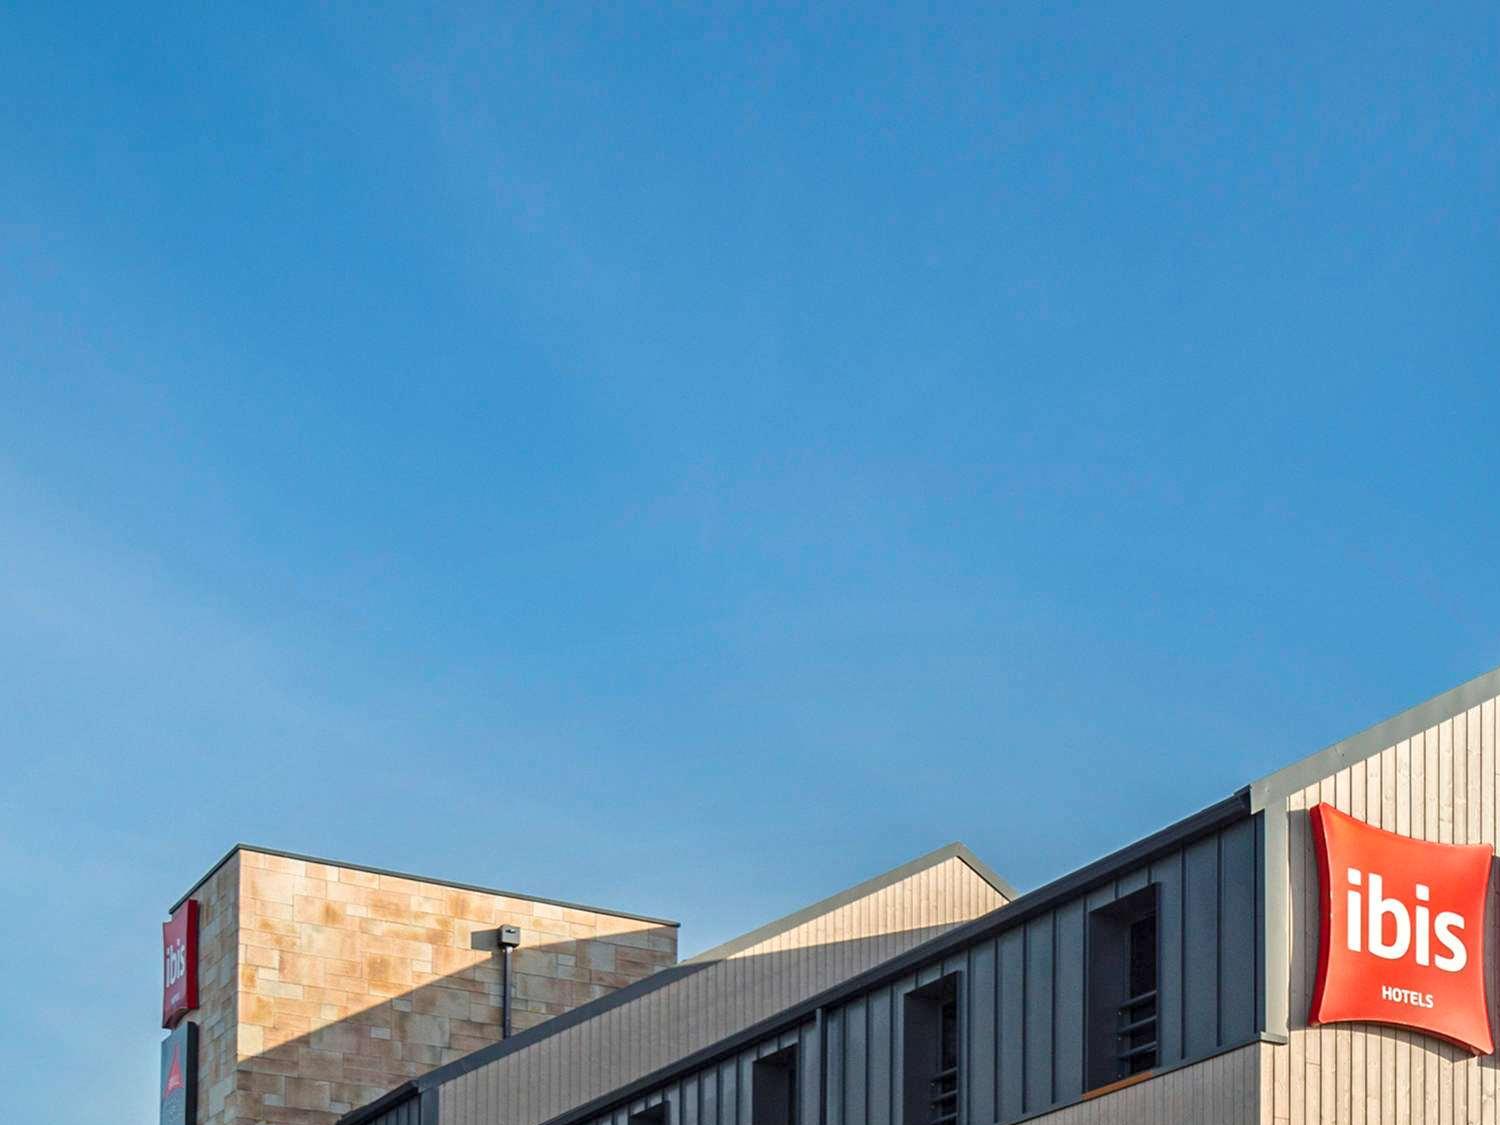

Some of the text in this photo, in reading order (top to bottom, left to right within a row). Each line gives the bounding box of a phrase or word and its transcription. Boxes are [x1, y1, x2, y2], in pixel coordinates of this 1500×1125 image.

[1347, 867, 1468, 973] ibis
[166, 938, 185, 988] ibis
[1381, 985, 1434, 1009] HOTELS
